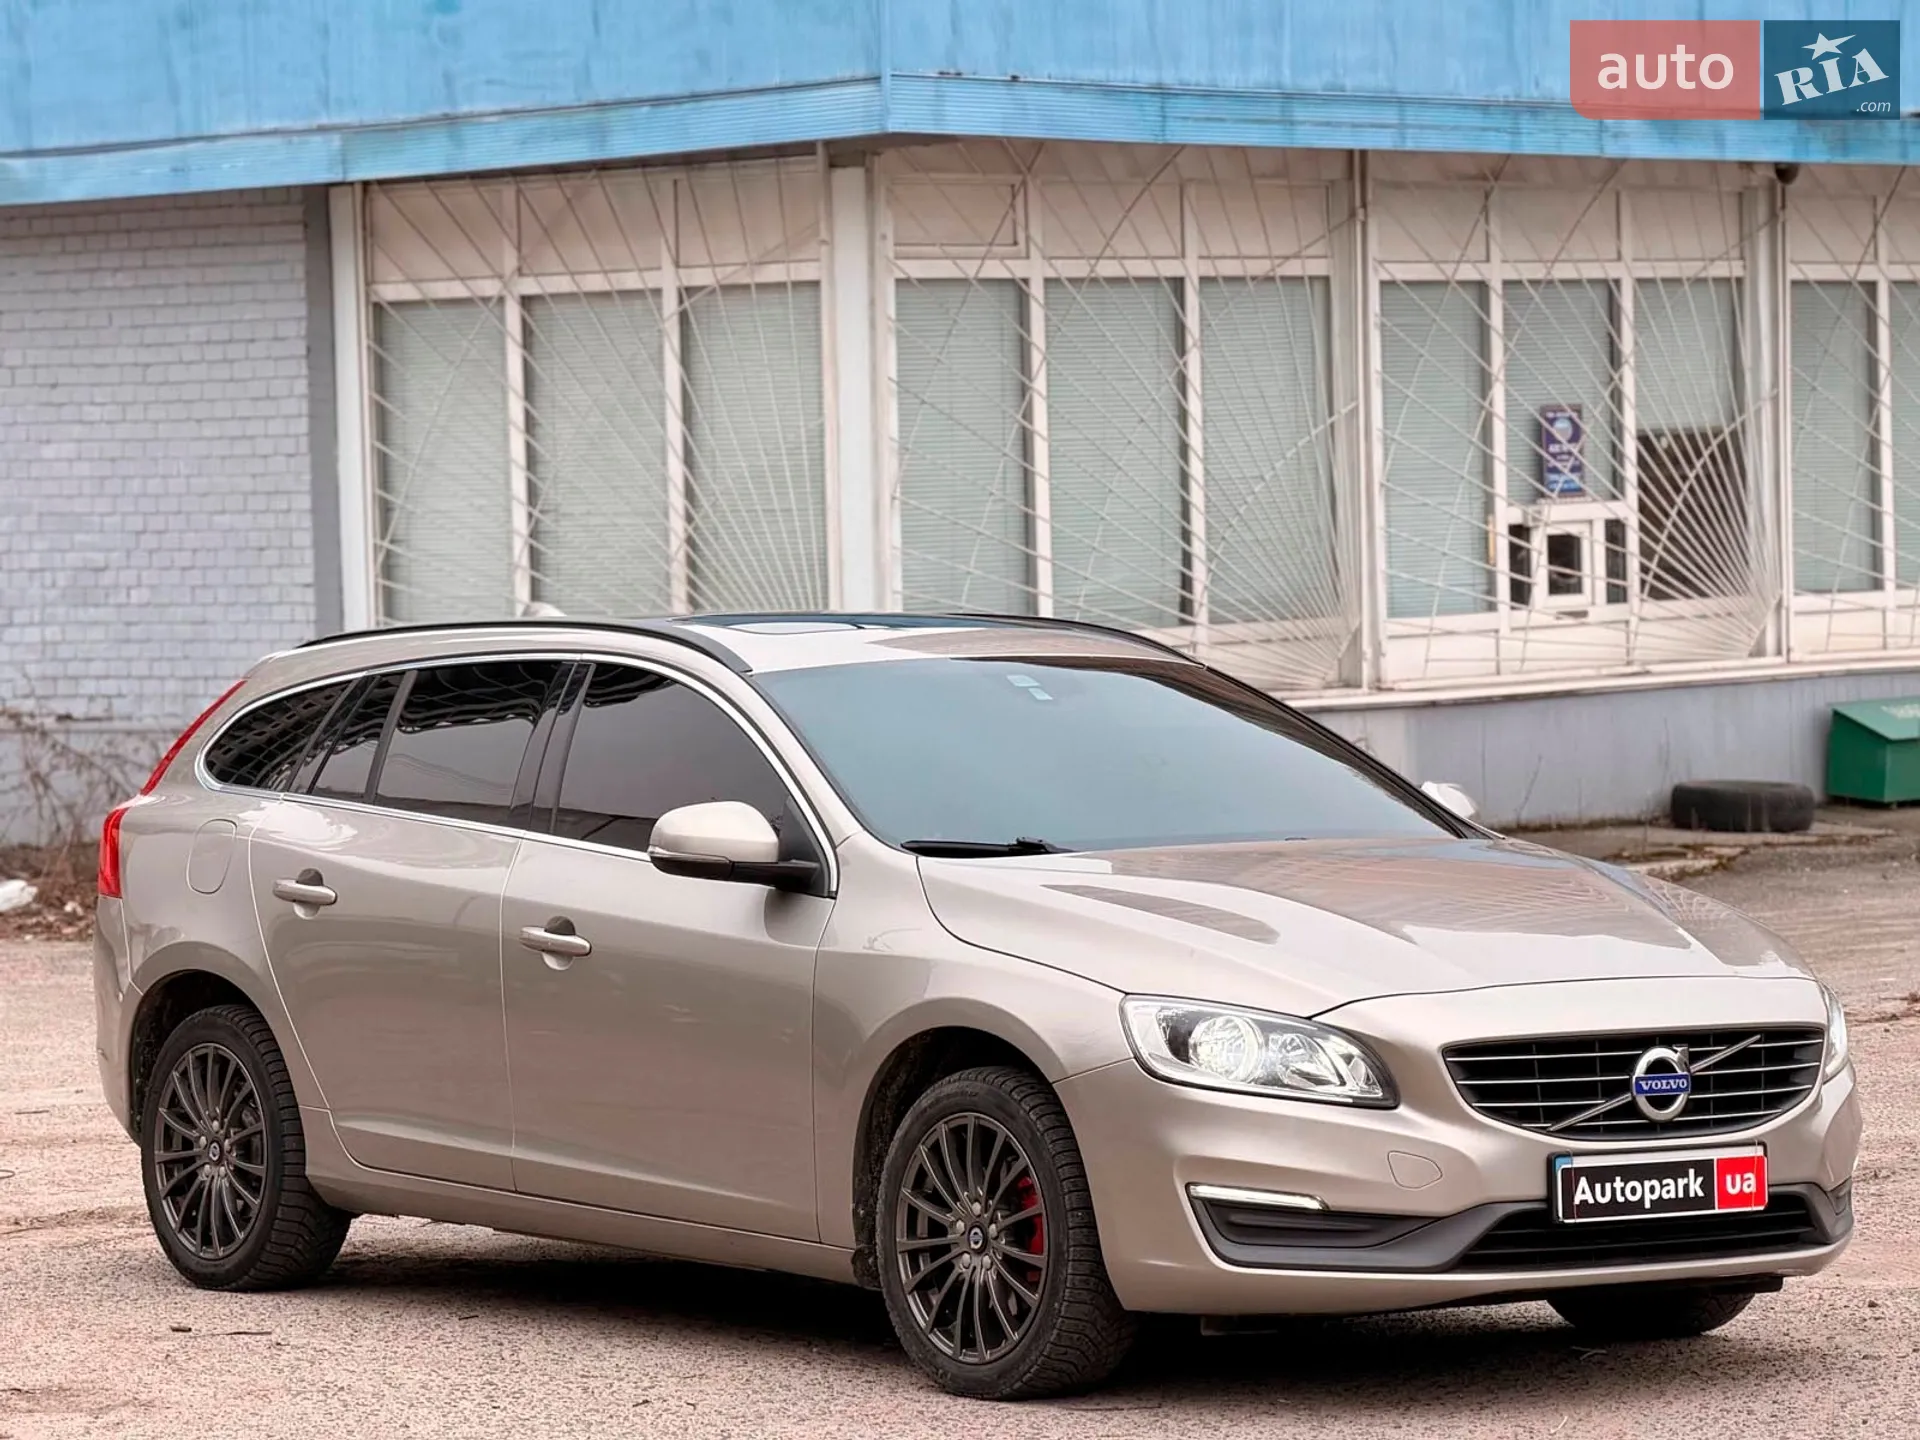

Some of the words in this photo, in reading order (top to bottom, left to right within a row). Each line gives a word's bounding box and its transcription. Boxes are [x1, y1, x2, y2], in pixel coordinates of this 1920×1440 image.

[1639, 1078, 1688, 1091] VOLVO
[1573, 1168, 1704, 1209] Autopark
[1725, 1172, 1757, 1195] ua
